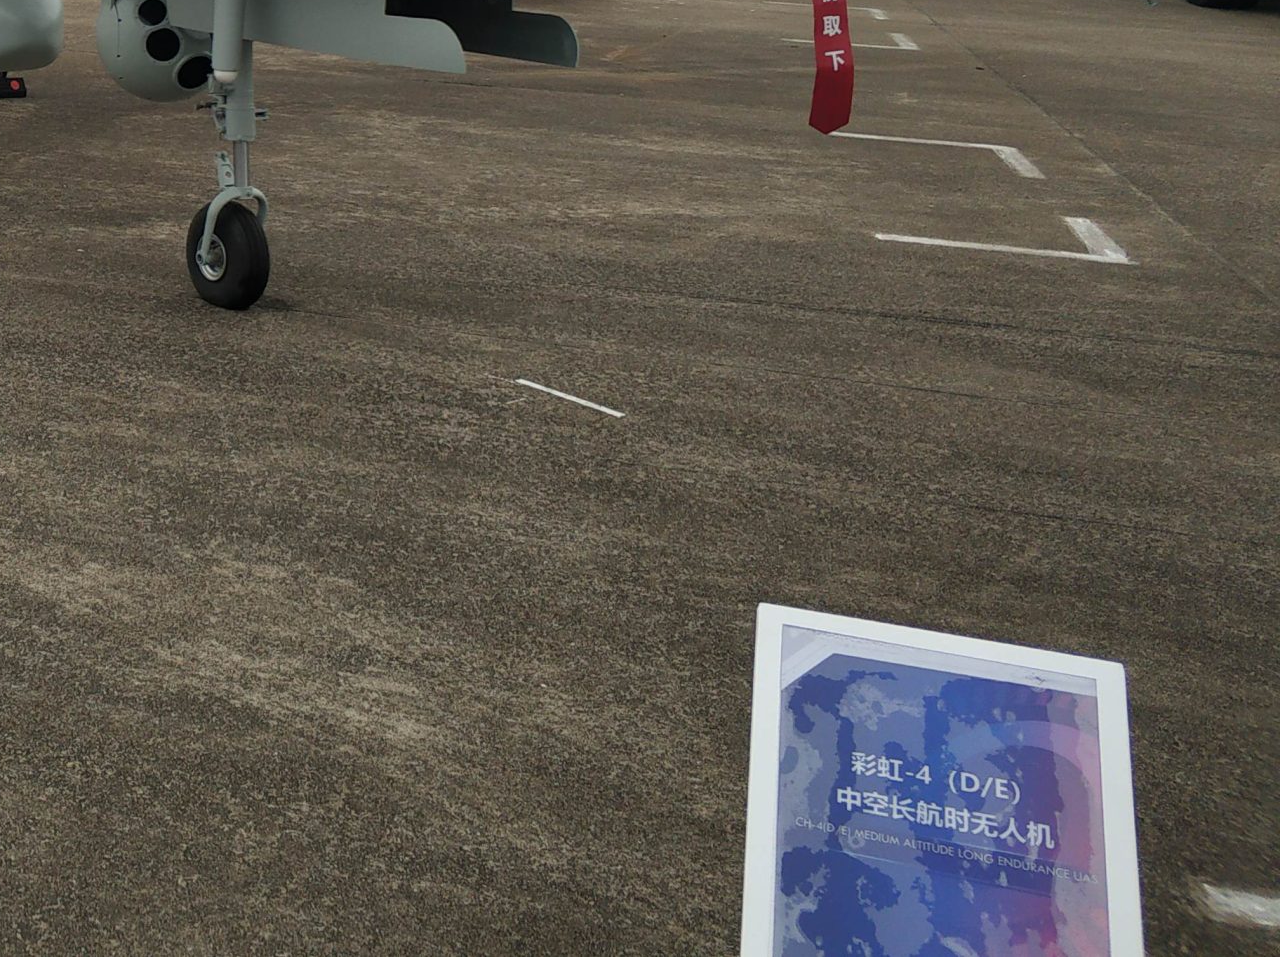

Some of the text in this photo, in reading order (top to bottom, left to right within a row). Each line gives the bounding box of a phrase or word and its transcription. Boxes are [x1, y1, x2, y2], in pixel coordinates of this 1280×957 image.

[836, 786, 1055, 850] 中空长航时无人机
[854, 828, 900, 846] MEDIUM
[903, 838, 954, 858] ALTITUDE
[958, 848, 995, 866] LONG
[997, 856, 1071, 881] ENDURANCE
[1073, 871, 1099, 884] UAS
